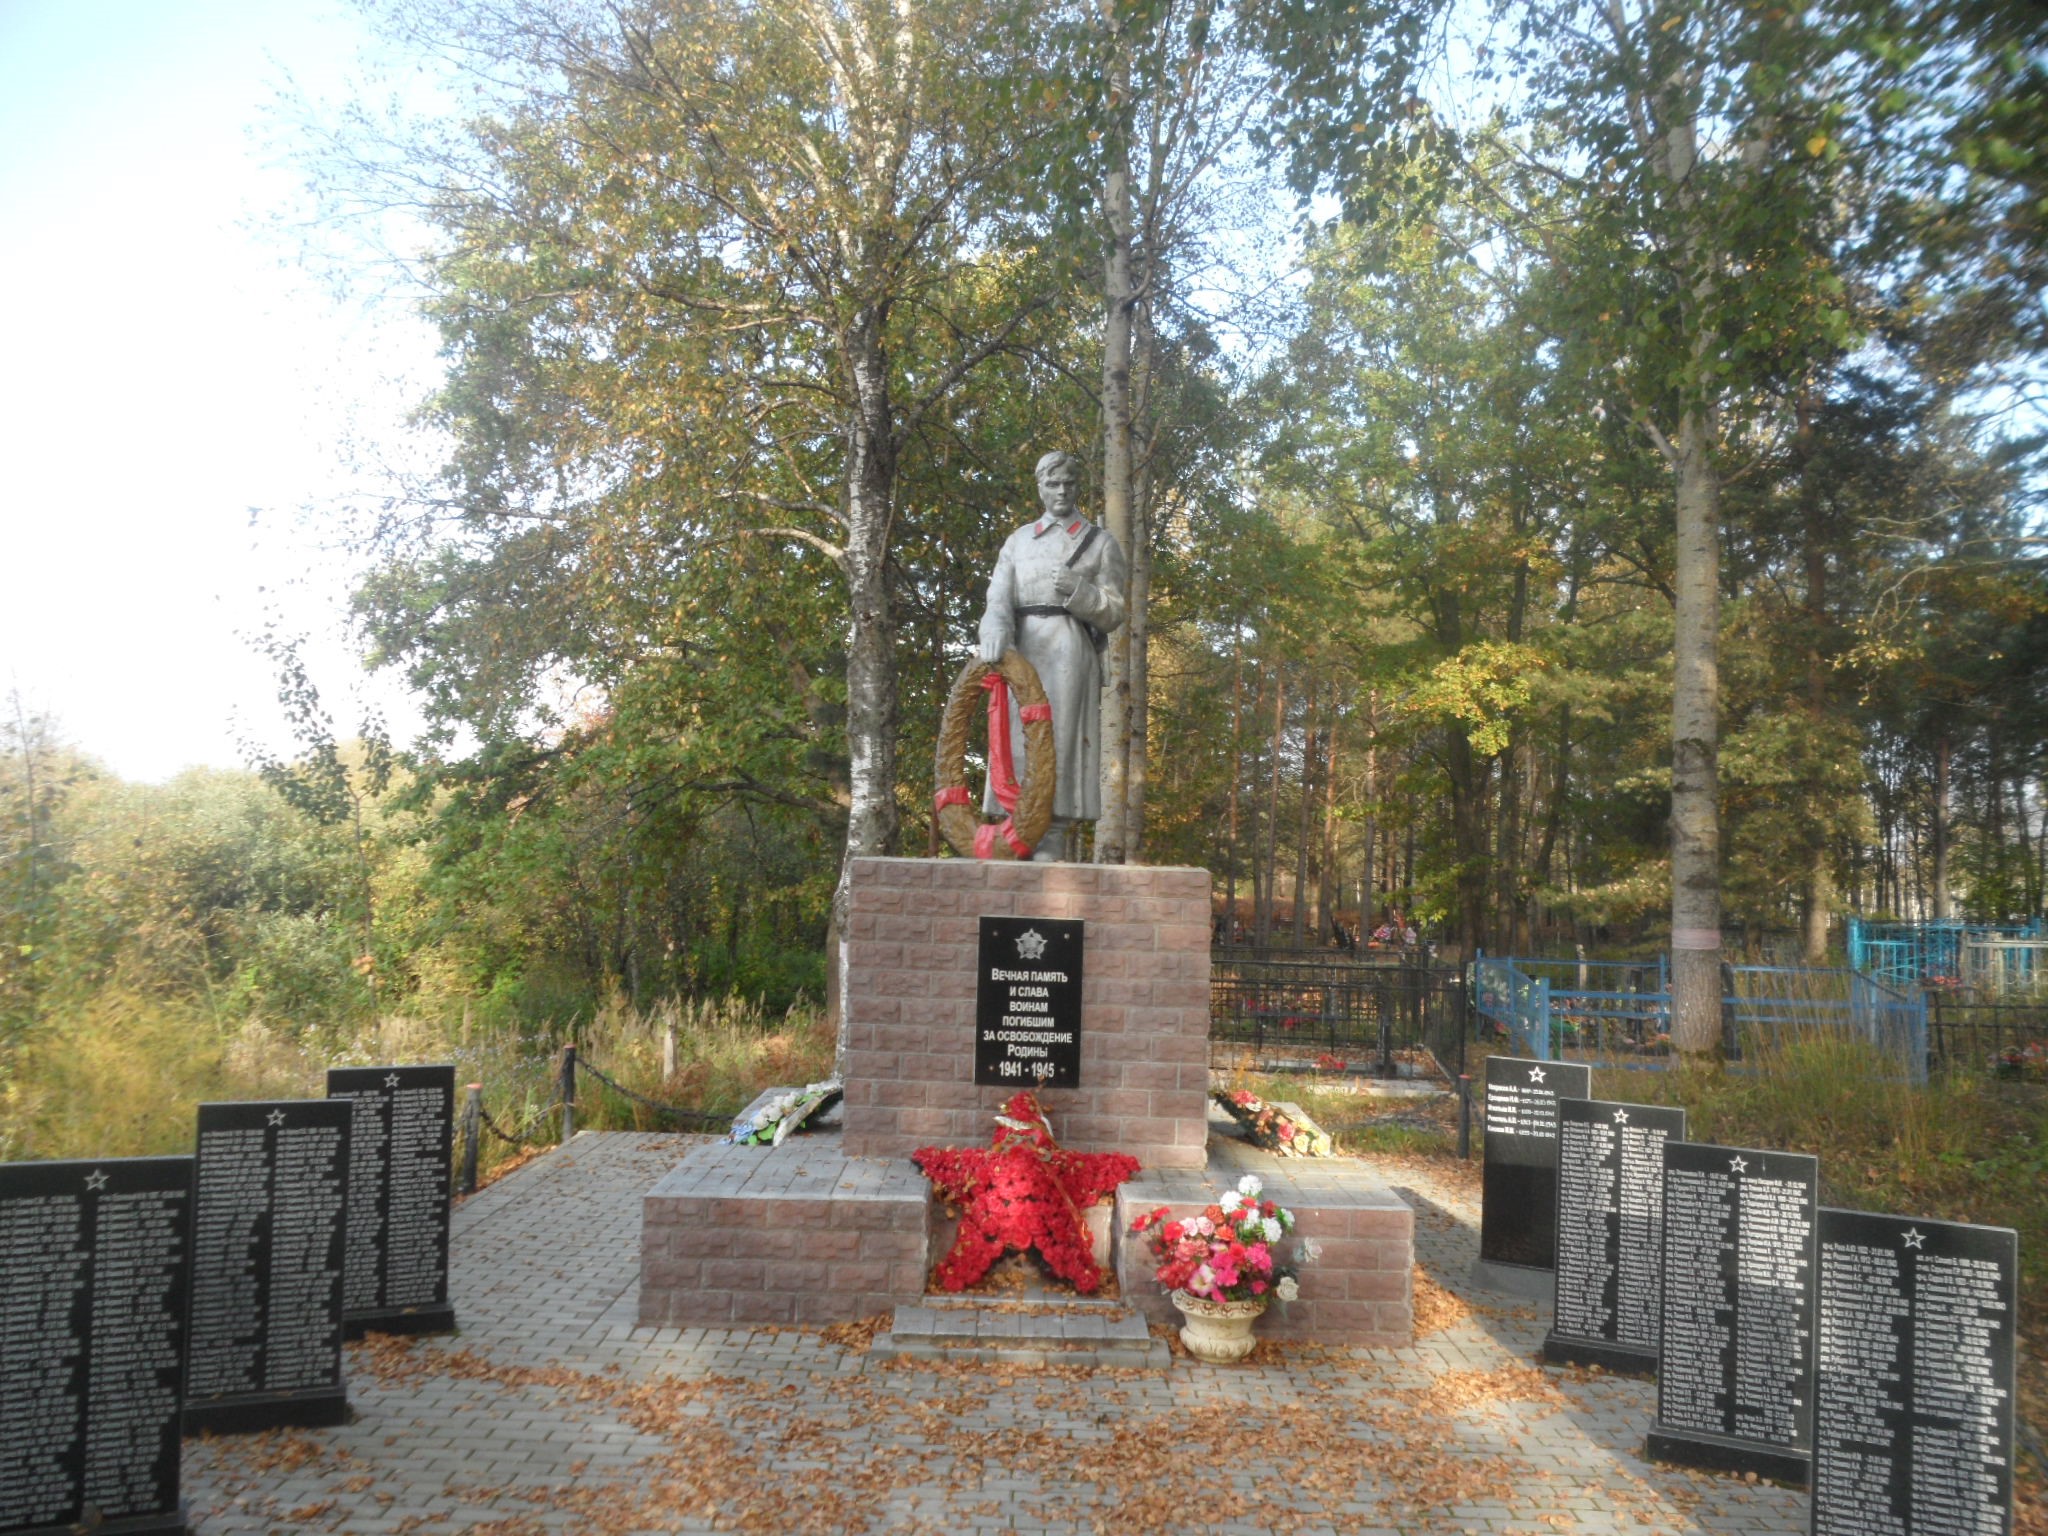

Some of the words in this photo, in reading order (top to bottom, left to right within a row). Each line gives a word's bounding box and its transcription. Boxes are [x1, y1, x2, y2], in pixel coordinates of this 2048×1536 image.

[1030, 971, 1068, 983] ПАМЯТЬ
[1009, 986, 1016, 997] И
[1018, 986, 1049, 997] СЛАВА
[1009, 1001, 1048, 1012] ВОИНАМ
[1002, 1016, 1055, 1028] ПОГИБШИМ
[983, 1030, 995, 1040] ЗА
[997, 1031, 1073, 1044] ОСВОБОЖДЕНИЕ
[999, 1061, 1022, 1077] 1941
[1031, 1061, 1055, 1078] 1945
